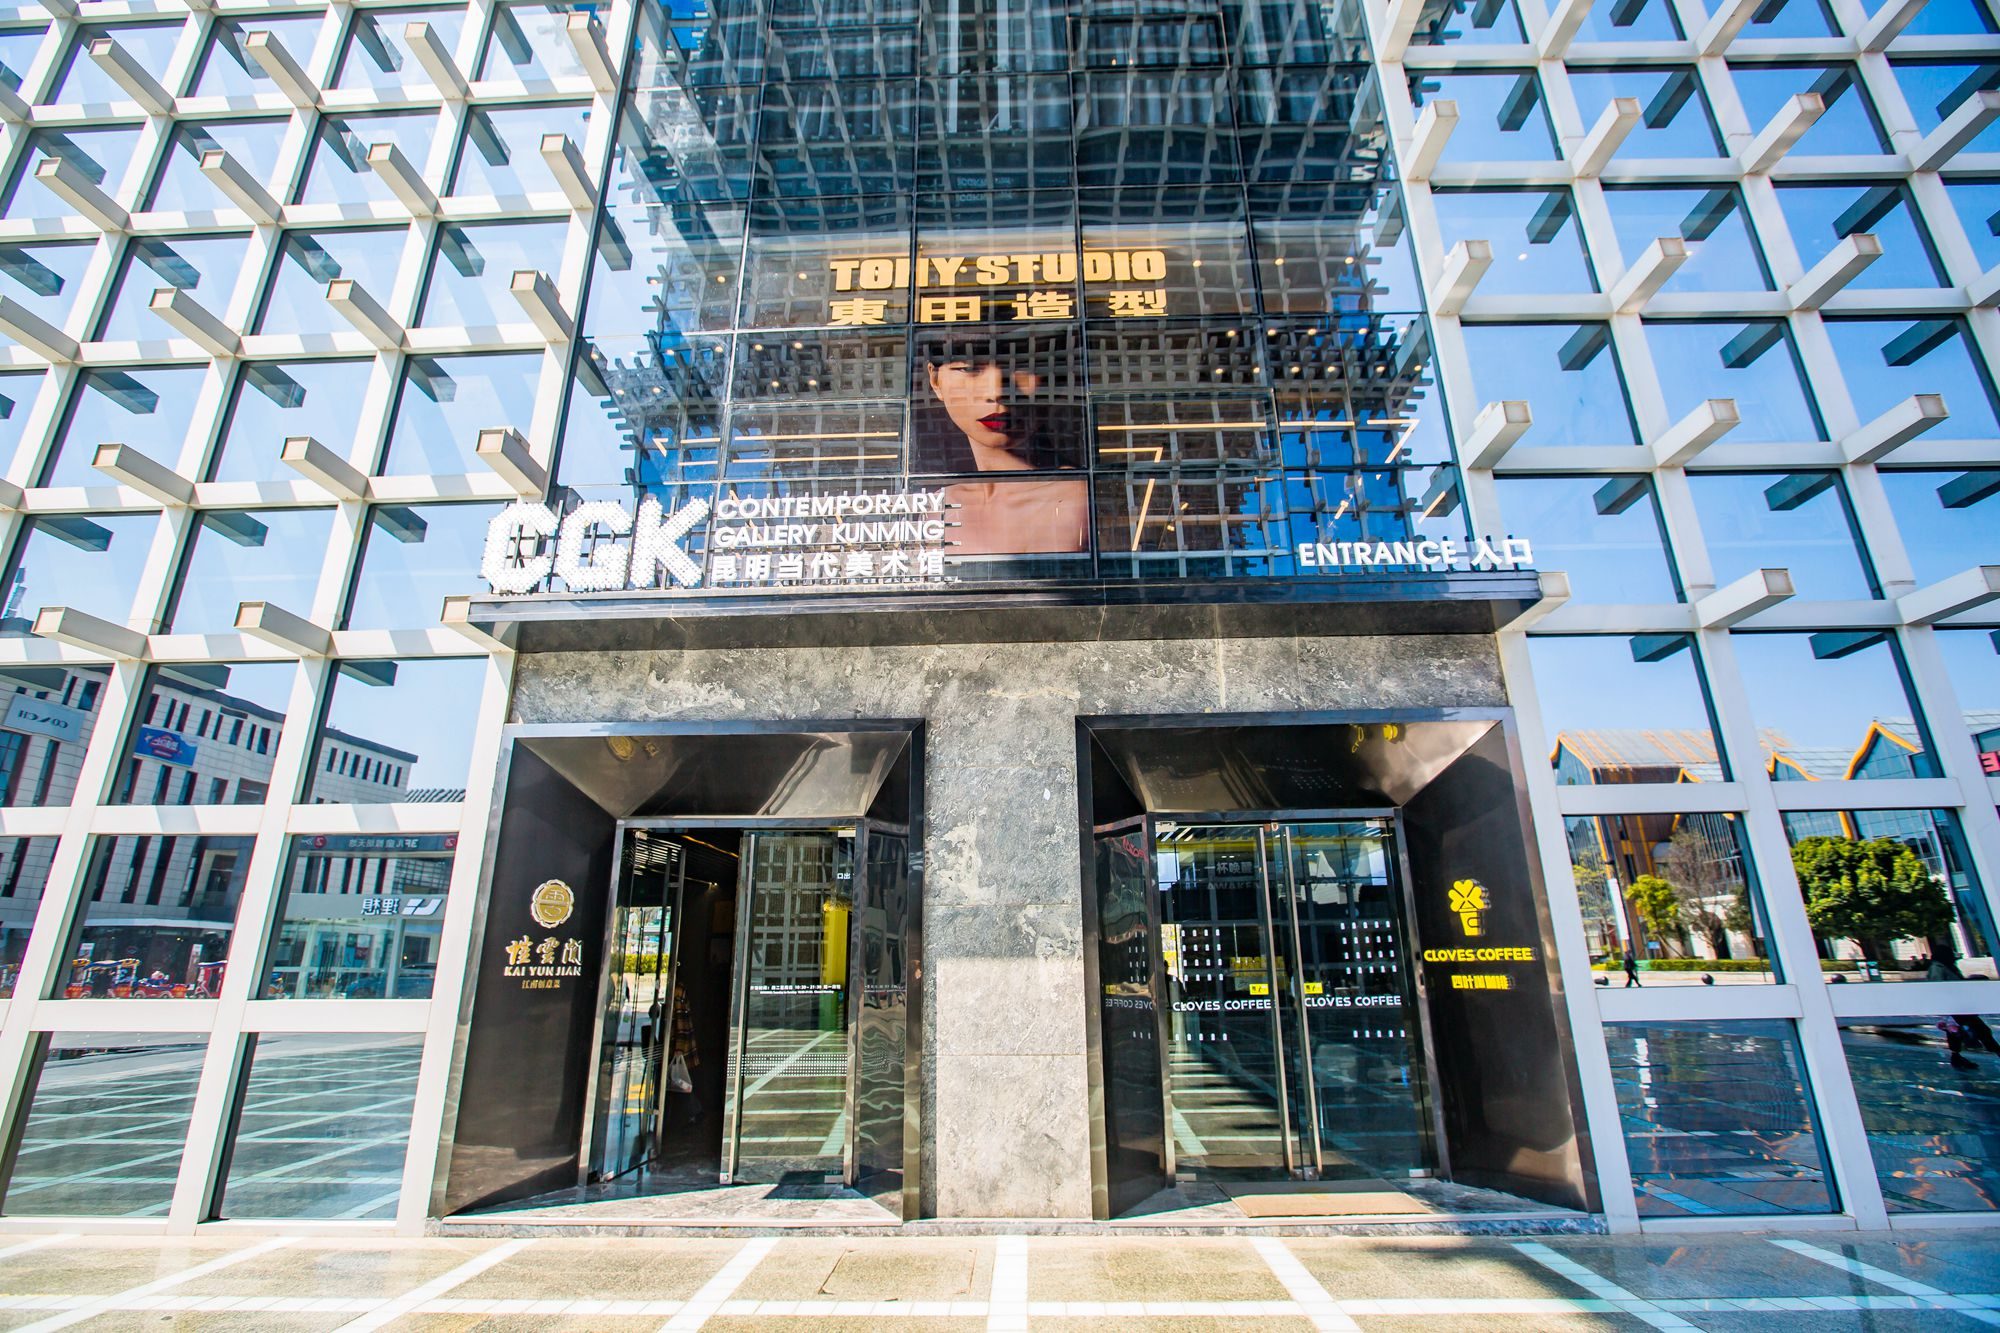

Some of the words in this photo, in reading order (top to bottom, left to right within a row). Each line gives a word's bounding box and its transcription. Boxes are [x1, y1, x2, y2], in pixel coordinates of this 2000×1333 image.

[976, 250, 1167, 286] STUDIO
[716, 491, 945, 519] CONTEMPORARY
[481, 499, 709, 595] CGK
[715, 524, 816, 547] GALLERY
[832, 520, 944, 543] KUNMING
[712, 548, 945, 581] 昆明当代美术馆
[1298, 541, 1458, 567] ENTRANCE
[1471, 538, 1534, 567] 入口
[1424, 949, 1475, 962] CLOVES
[1476, 947, 1534, 961] COFFEE
[504, 966, 525, 976] KAI
[529, 966, 553, 976] YUN
[555, 966, 581, 976] JIAN
[1172, 1000, 1221, 1012] CLOVES
[1224, 999, 1272, 1010] COFFEE
[1304, 996, 1352, 1008] CLOVES
[1354, 995, 1402, 1006] COFFEE
